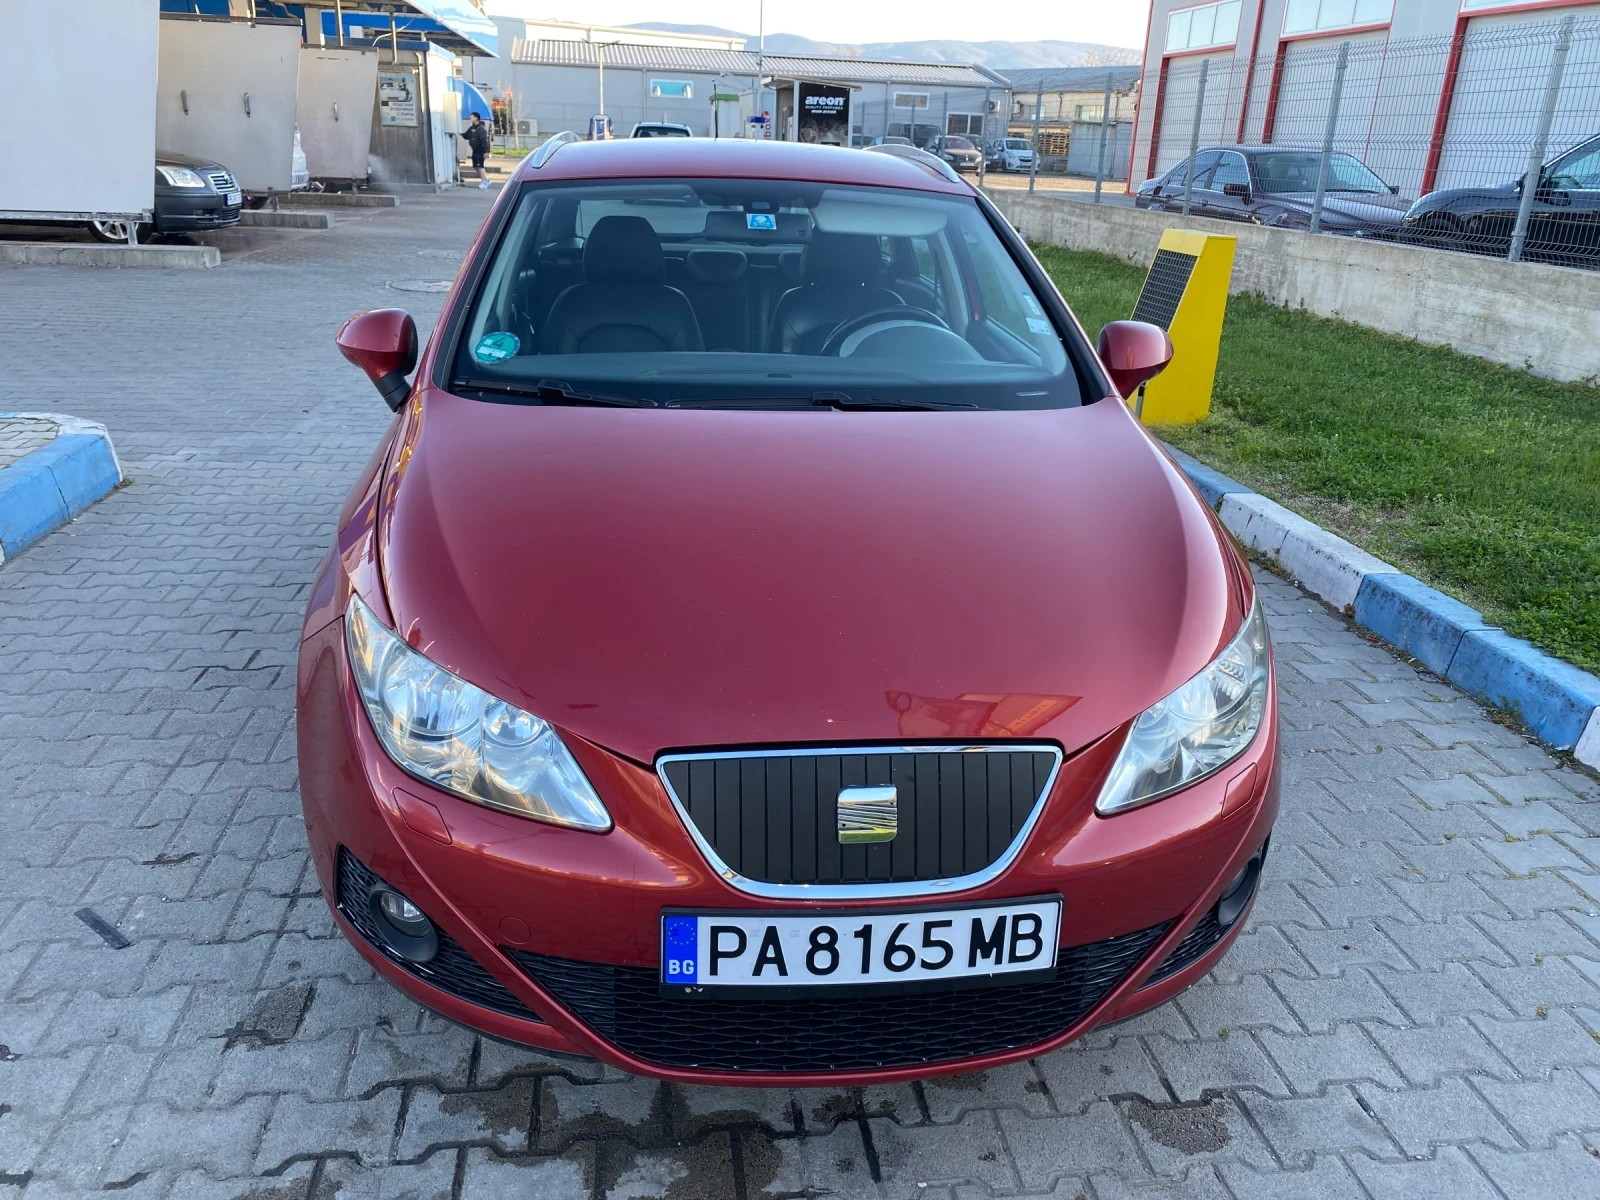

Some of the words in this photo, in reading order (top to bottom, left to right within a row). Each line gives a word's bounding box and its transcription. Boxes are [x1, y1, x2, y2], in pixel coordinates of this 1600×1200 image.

[805, 96, 844, 105] areon
[806, 920, 954, 976] 8165
[668, 959, 695, 975] BG
